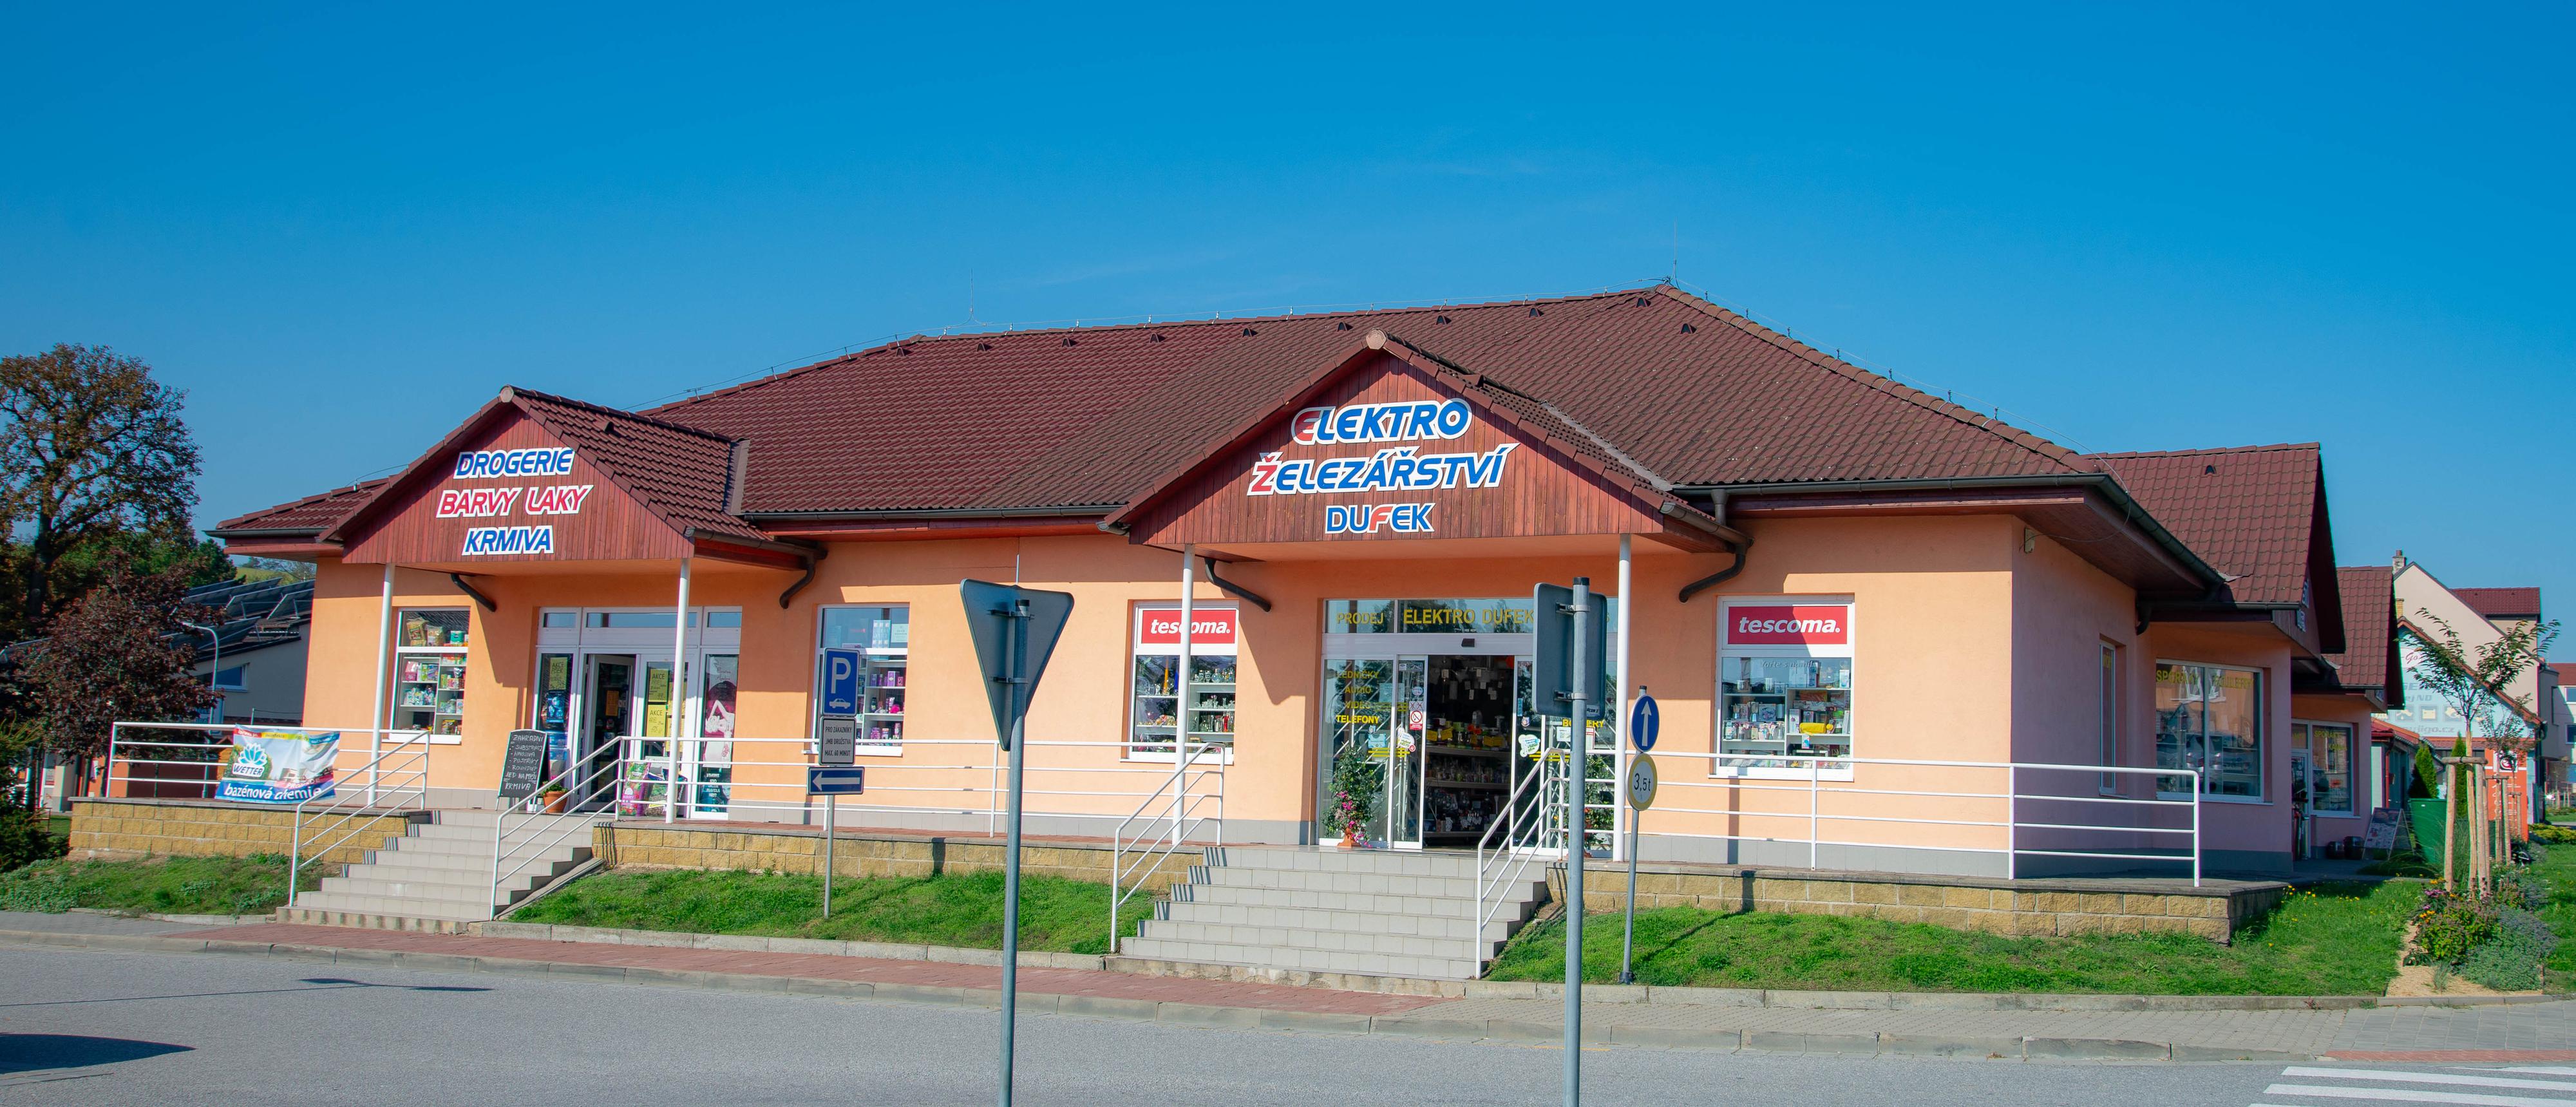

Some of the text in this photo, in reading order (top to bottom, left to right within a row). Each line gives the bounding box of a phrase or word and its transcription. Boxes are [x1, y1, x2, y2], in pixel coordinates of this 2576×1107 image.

[1293, 399, 1470, 443] ELEKTRO
[454, 448, 574, 478] DROGERIE
[1249, 444, 1515, 494] ŽELEZÁŘSTVÍ
[438, 486, 591, 516] BARVY LAKY
[1326, 504, 1434, 533] DUFEK
[463, 527, 553, 554] KRMIVA
[1336, 609, 1534, 625] PRODEJ ELEKTRO DUFEK
[1738, 617, 1841, 633] tescoma.
[831, 657, 851, 694] P
[1345, 685, 1372, 694] AUDIO
[1345, 701, 1371, 709] VIDEO
[1336, 715, 1380, 724] TELEFONY
[833, 724, 853, 733] ZÁKAZNÍKY
[233, 764, 263, 775] WETTER
[223, 784, 322, 800] bazénová chemie
[505, 782, 531, 791] KRMIVA
